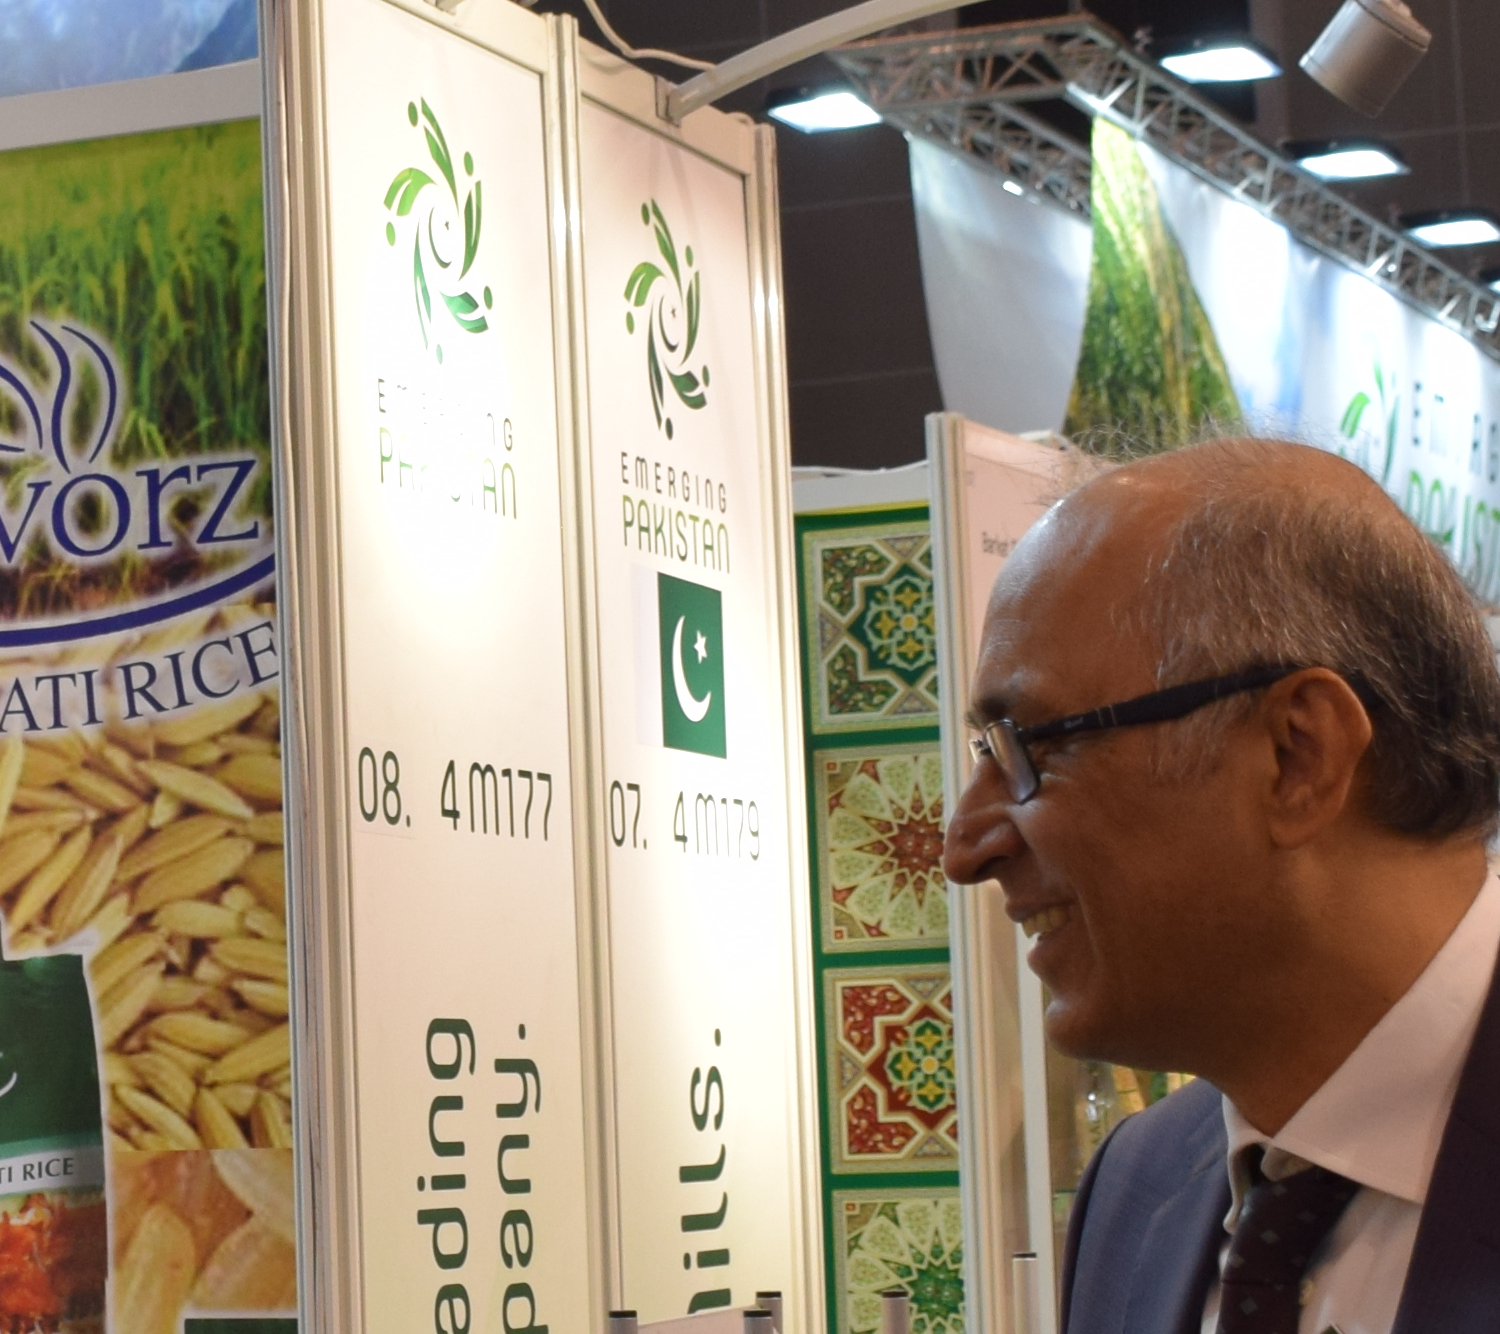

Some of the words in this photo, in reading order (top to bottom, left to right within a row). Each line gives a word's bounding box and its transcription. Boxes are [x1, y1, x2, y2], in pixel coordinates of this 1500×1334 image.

[620, 451, 726, 514] EMERGING
[622, 494, 730, 574] PAKISTAN
[118, 620, 281, 722] RICE
[357, 746, 411, 828] 08.
[609, 780, 648, 850] 07.
[22, 1157, 75, 1182] RICE
